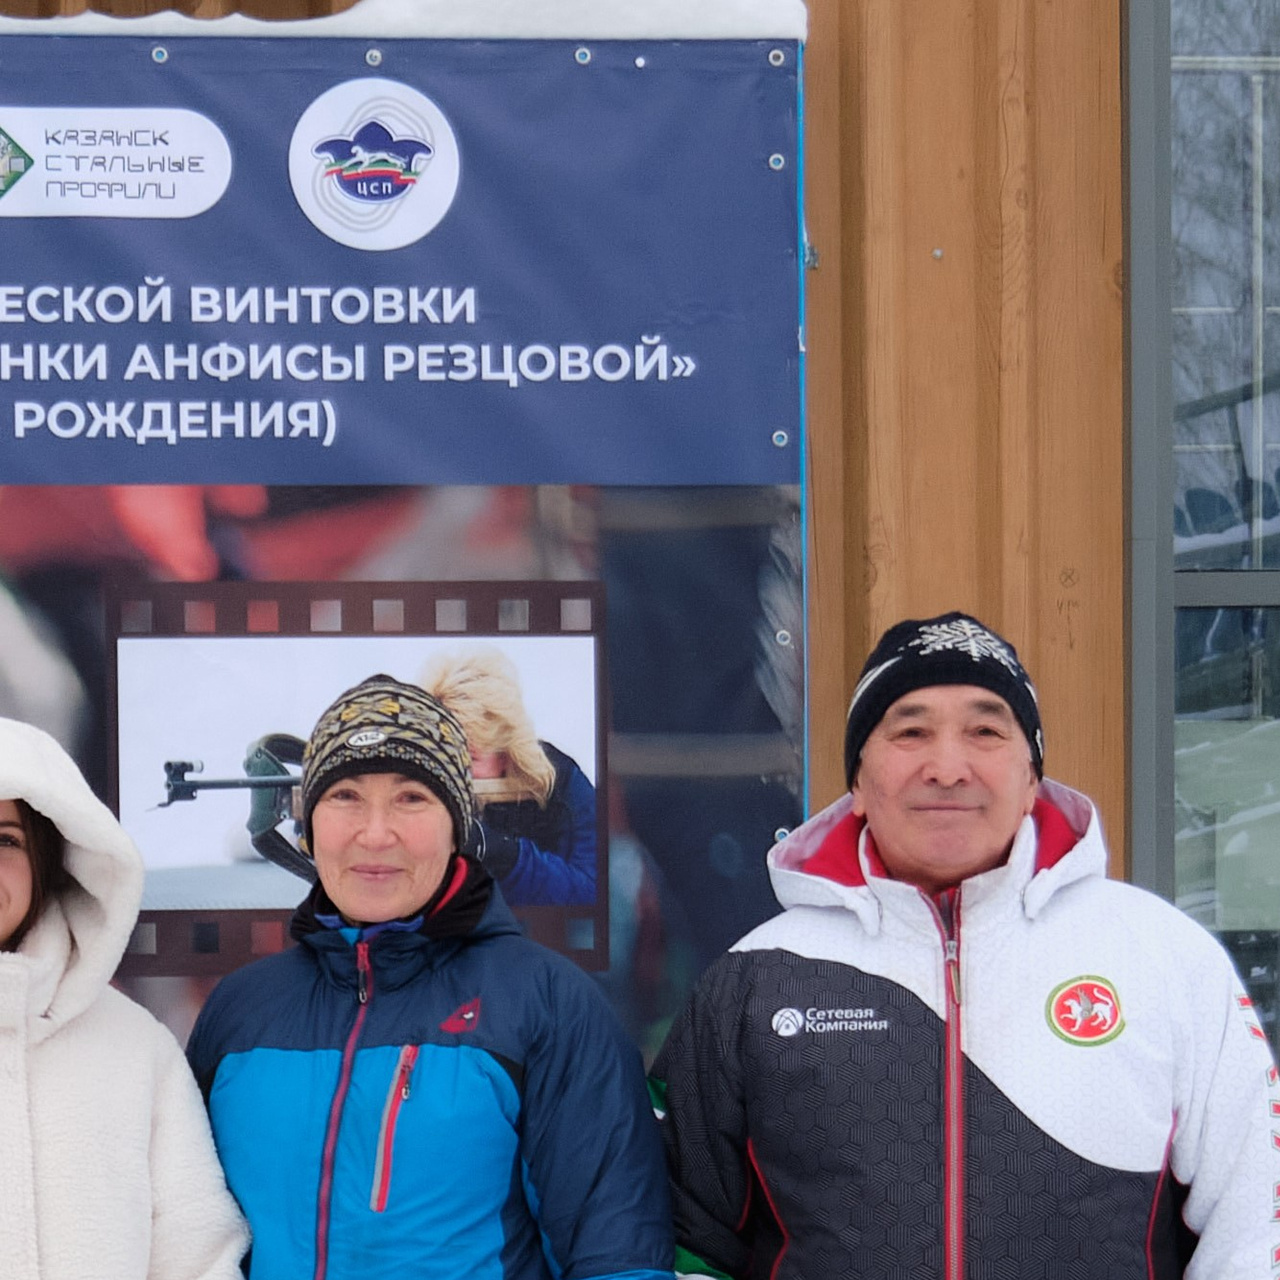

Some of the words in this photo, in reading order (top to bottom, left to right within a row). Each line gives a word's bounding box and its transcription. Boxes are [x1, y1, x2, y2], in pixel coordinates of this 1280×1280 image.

[45, 155, 206, 173] СТАЛЬНЫЕ
[45, 180, 176, 199] ПРОФИЛИ
[357, 181, 393, 196] ЦСП
[191, 286, 476, 324] ВИНТОВКИ
[124, 342, 365, 382] АНФИСЫ
[383, 335, 697, 388] РЕЗЦОВОЙ»
[15, 399, 337, 447] РОЖДЕНИЯ)
[805, 1007, 875, 1021] Сетевая
[805, 1020, 889, 1034] Компания
